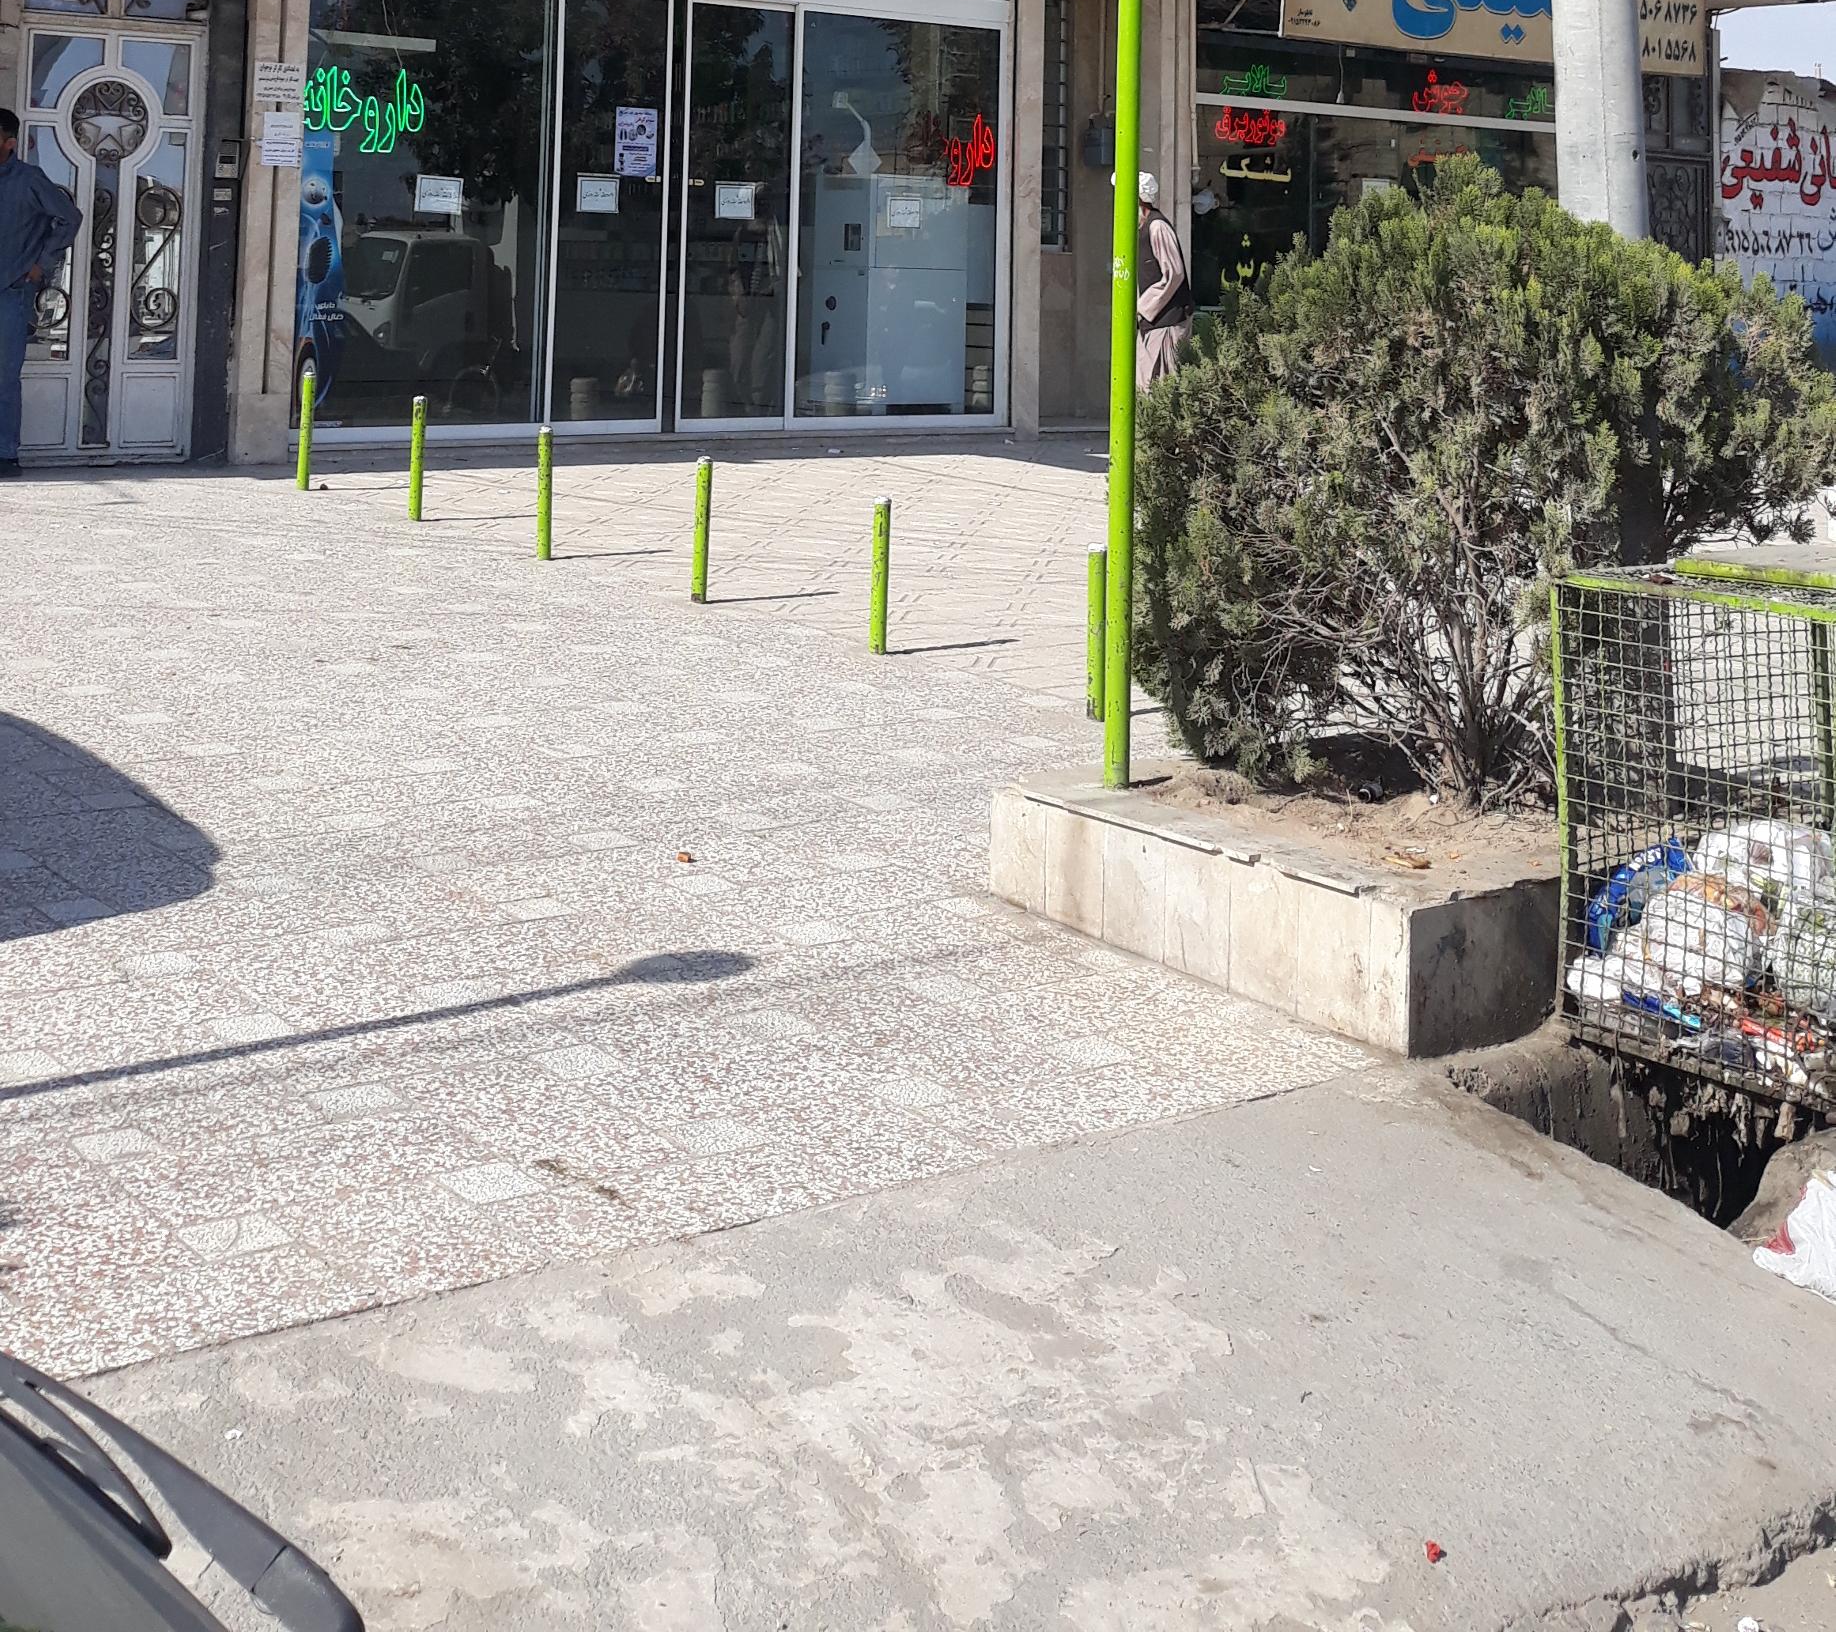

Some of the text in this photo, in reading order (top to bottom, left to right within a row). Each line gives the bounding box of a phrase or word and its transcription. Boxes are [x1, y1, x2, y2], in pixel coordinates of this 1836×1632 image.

[1412, 69, 1469, 115] جوش
[1505, 87, 1555, 120] الابر
[1220, 156, 1292, 195] بشکه
[1720, 117, 1802, 210] شفیعی
